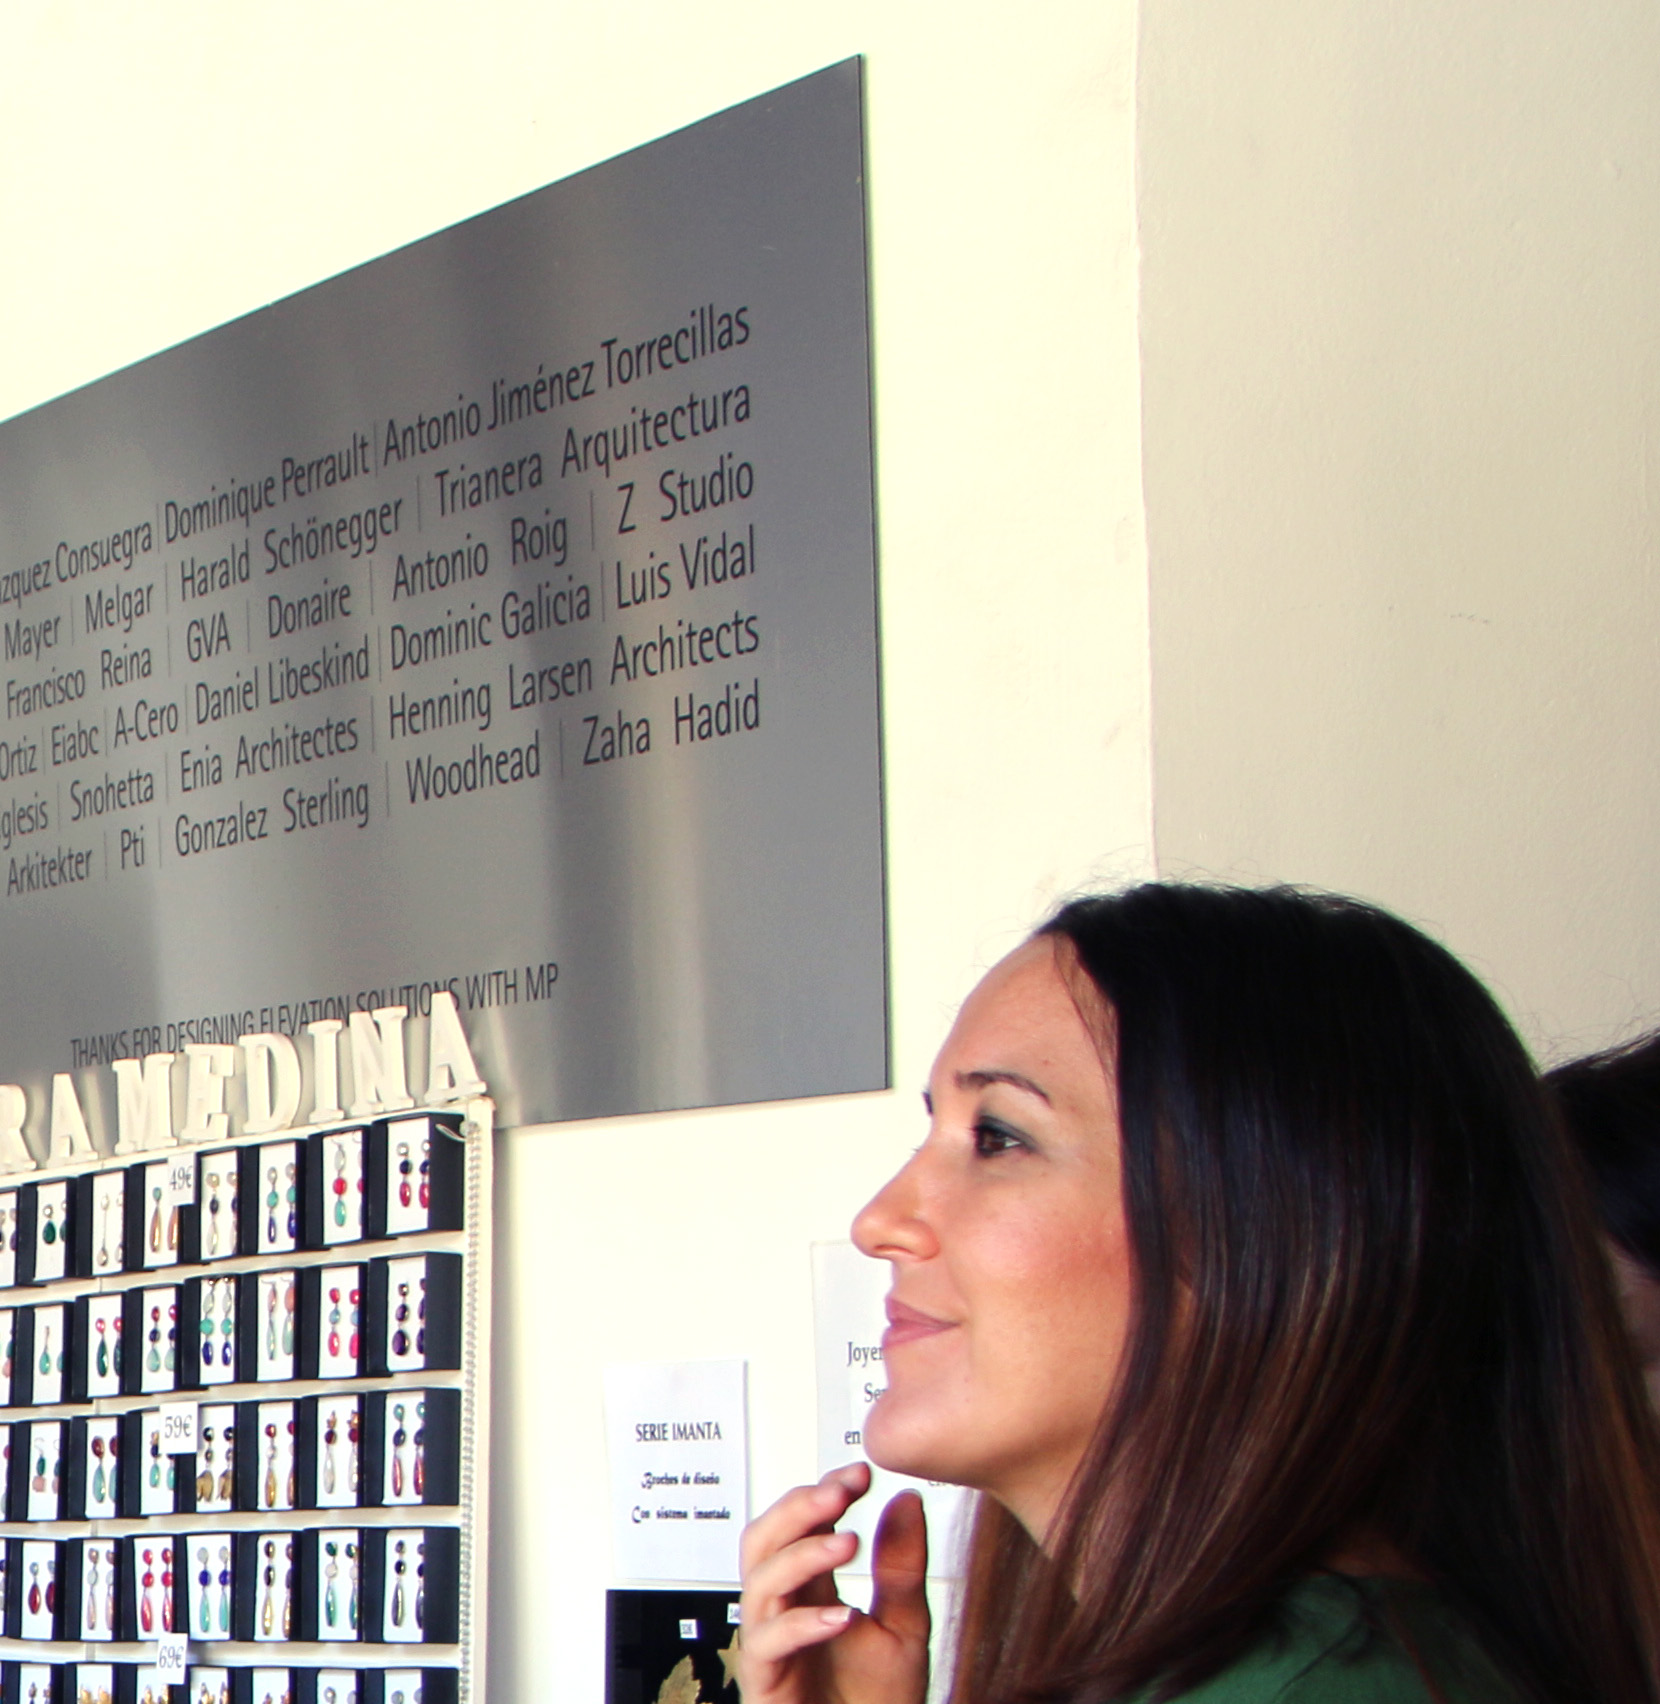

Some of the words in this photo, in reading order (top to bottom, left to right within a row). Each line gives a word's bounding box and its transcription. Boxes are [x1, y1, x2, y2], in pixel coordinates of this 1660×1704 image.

[4, 615, 61, 663] Mayer
[85, 582, 154, 634] Melgar
[181, 539, 250, 601] Harald
[264, 497, 403, 574] Schönegger
[435, 451, 543, 517] Trianera
[561, 384, 751, 479] Arquitectura
[56, 521, 152, 584] Consuegra
[165, 476, 276, 543] Dominique
[281, 432, 370, 501] Perrault
[384, 393, 481, 466] Antonio
[486, 361, 596, 431] Jiménez
[601, 303, 751, 389] Torrecillas
[6, 666, 85, 719] Francisco
[101, 642, 152, 690] Reina
[186, 611, 231, 663] GVA
[268, 577, 352, 638] Donaire
[393, 533, 488, 601] Antonio
[511, 509, 568, 567] Roig
[617, 481, 637, 535] Z
[659, 451, 754, 523] Studio
[51, 720, 100, 766] Eiabc
[114, 699, 179, 749] A-Cero
[196, 667, 260, 725] Daniel
[268, 633, 370, 705] Libeskind
[391, 602, 492, 671] Dominic
[501, 573, 591, 640] Galicia
[616, 552, 672, 610] Luis
[679, 523, 757, 591] Vidal
[6, 846, 93, 897] Arkitekter
[121, 824, 145, 870] Pti
[175, 801, 269, 857] Gonzalez
[283, 777, 370, 833] Sterling
[406, 729, 541, 804] Woodhead
[583, 710, 651, 766] Zaha
[674, 678, 761, 746] Hadid
[70, 768, 154, 822] Snohetta
[181, 744, 222, 793] Enia
[235, 717, 359, 779] Architectes
[390, 678, 492, 740] Henning
[509, 657, 593, 711] Larsen
[610, 609, 760, 686] Architects
[70, 1030, 129, 1069] THANKS
[133, 1026, 162, 1058] FOR
[167, 1010, 255, 1054] DESIGNING
[465, 968, 518, 1011] WITH
[525, 962, 559, 1003] MP
[111, 991, 488, 1156] MEDINA
[169, 1164, 193, 1190] 49€
[164, 1414, 193, 1439] 59€
[635, 1422, 669, 1442] SERIE
[672, 1421, 722, 1441] IMANTA
[844, 1430, 861, 1445] en
[159, 1645, 185, 1669] 69€
